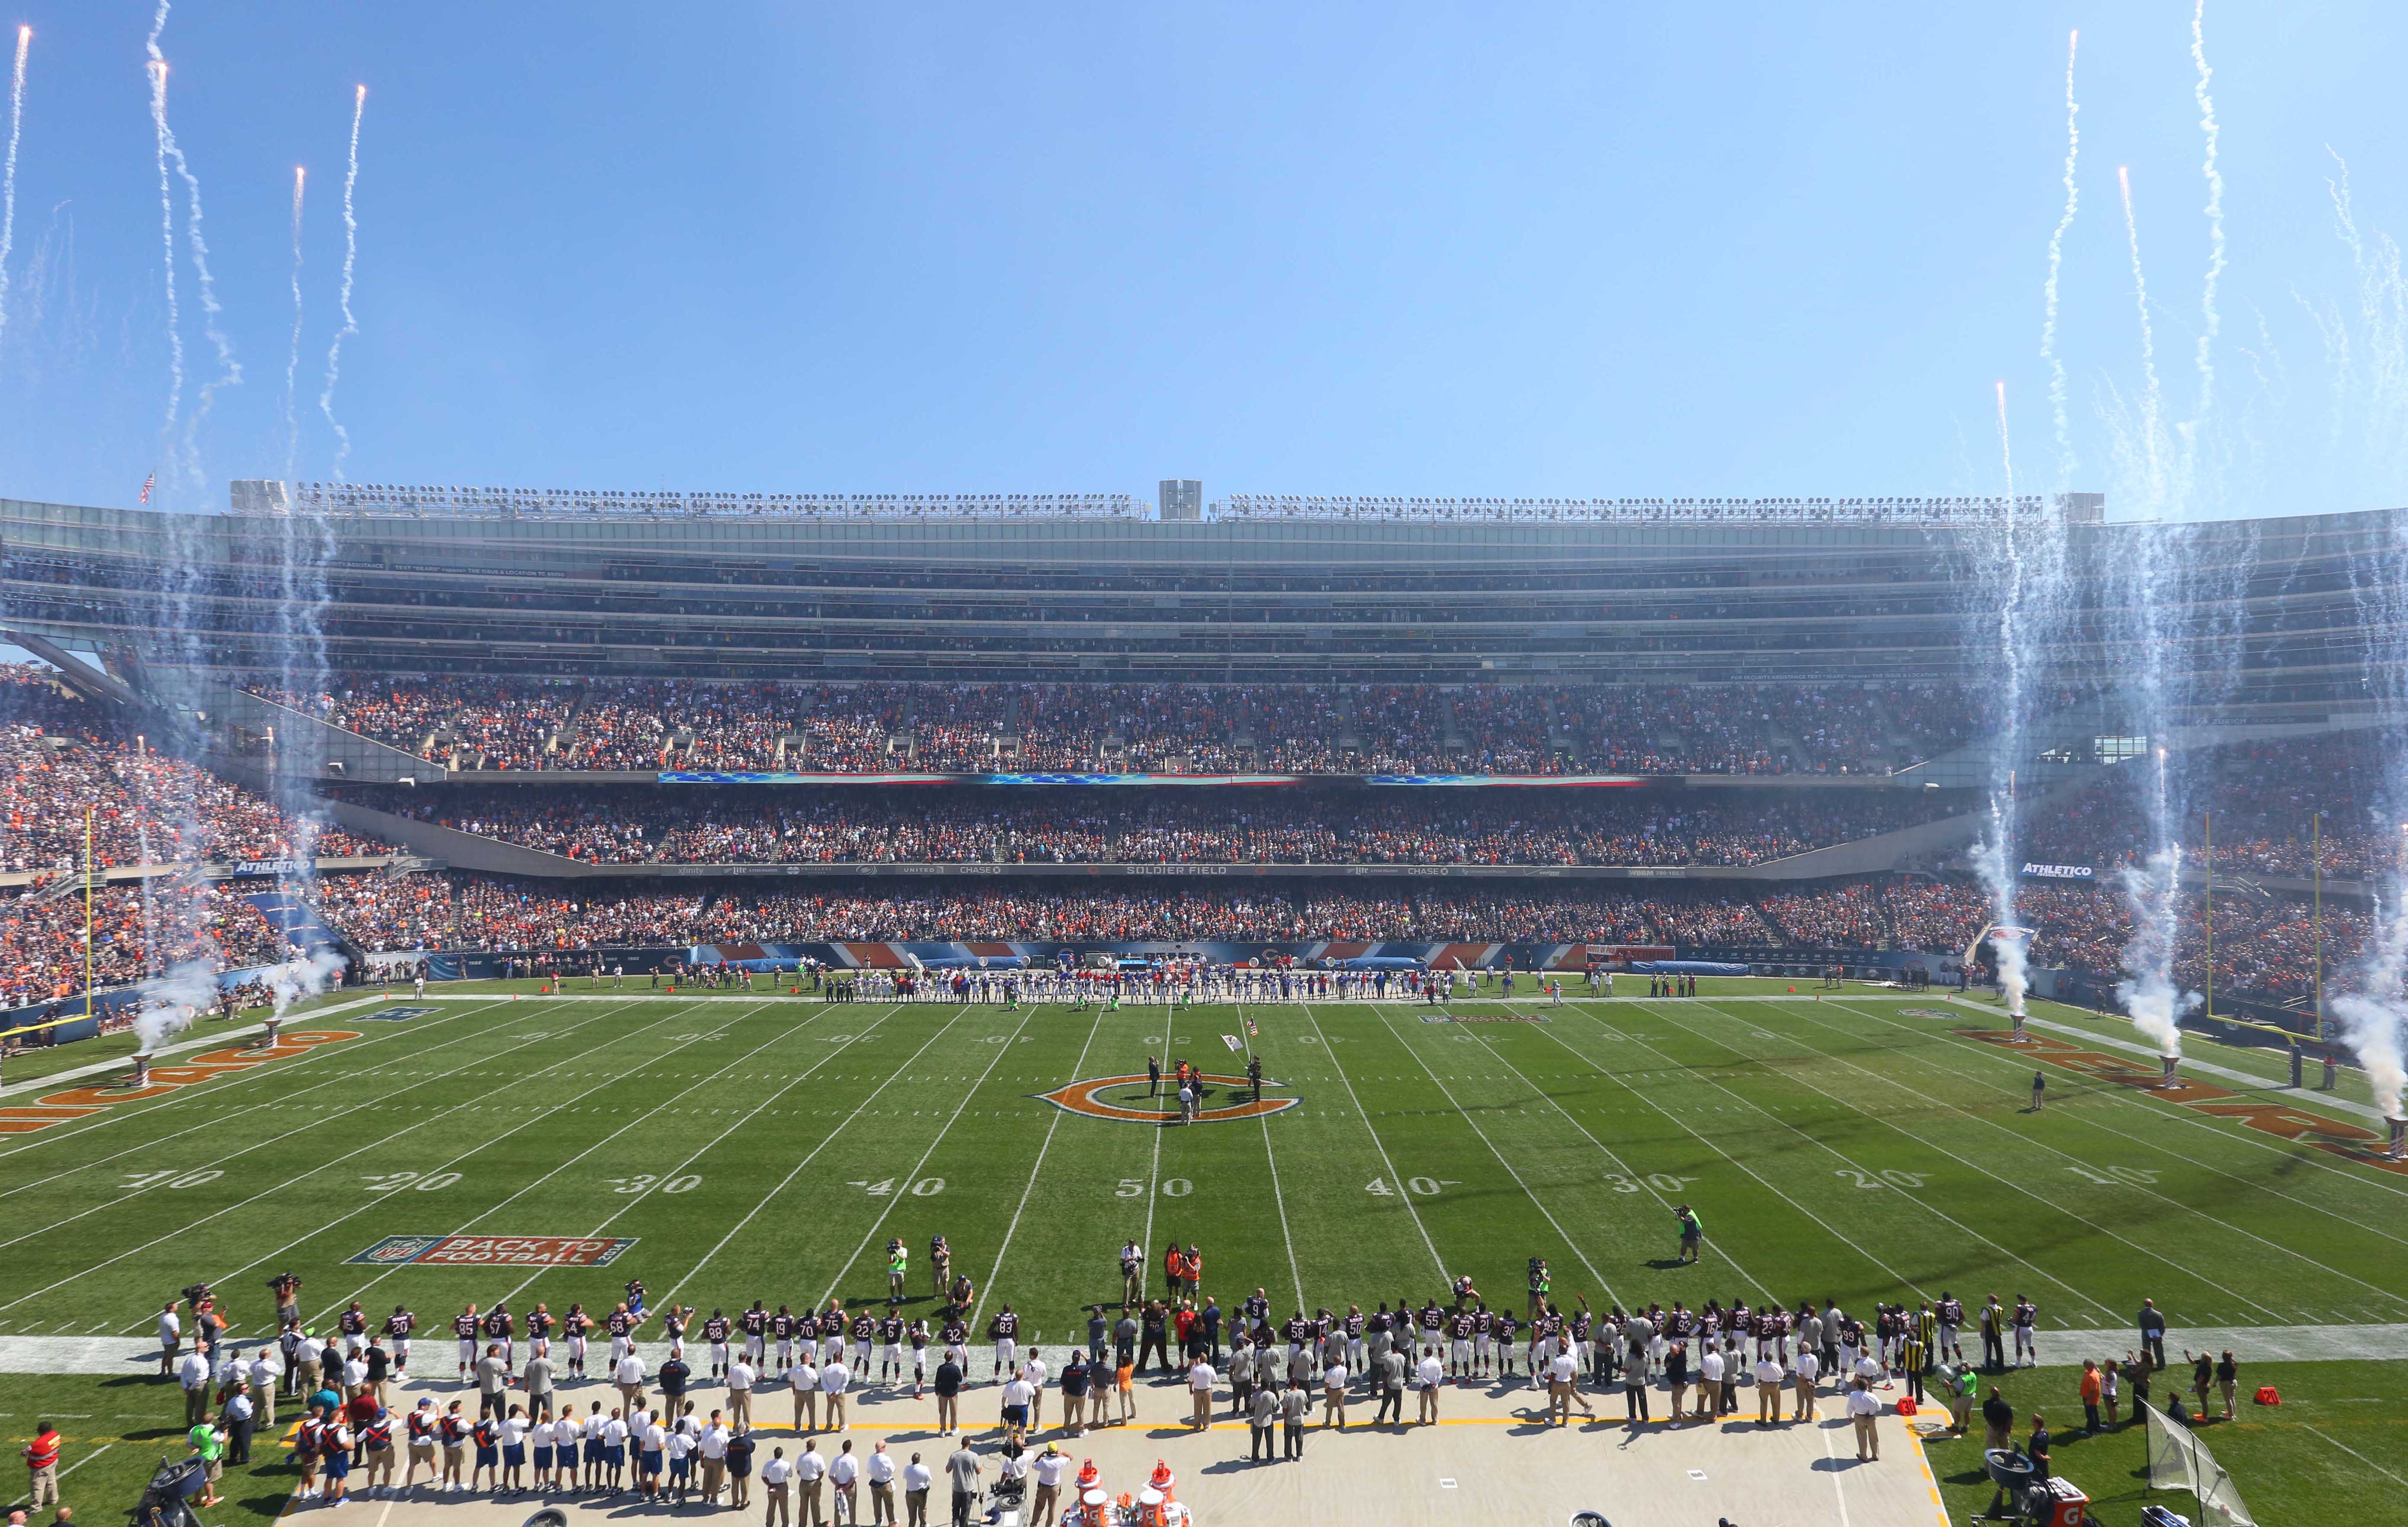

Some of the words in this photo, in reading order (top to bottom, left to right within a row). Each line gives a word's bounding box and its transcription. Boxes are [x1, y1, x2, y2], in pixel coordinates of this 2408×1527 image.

[678, 866, 704, 875] xfinity
[2022, 863, 2092, 876] ATHLETICO
[117, 1170, 225, 1189] 10
[1835, 1169, 1924, 1188] 20
[2064, 1165, 2159, 1185] 10
[364, 1172, 464, 1191] 20
[613, 1174, 702, 1193] 30
[866, 1177, 946, 1196] 40
[1114, 1178, 1194, 1197] 50
[1364, 1176, 1442, 1196] 40
[1602, 1174, 1685, 1193] 30
[442, 1239, 548, 1251] BACK
[558, 1241, 604, 1252] TO
[426, 1251, 585, 1263] FOOTBALL
[597, 1243, 627, 1261] 2014
[1253, 1305, 1258, 1315] 9
[1946, 1307, 1959, 1319] 90
[747, 1319, 760, 1331] 74
[825, 1319, 839, 1331] 75
[1425, 1315, 1438, 1326] 55
[1480, 1319, 1489, 1331] 21
[1678, 1320, 1690, 1332] 92
[1736, 1315, 1748, 1328] 95
[392, 1321, 407, 1334] 20
[459, 1323, 473, 1335] 85
[490, 1321, 500, 1335] 67
[610, 1321, 624, 1333] 68
[708, 1327, 723, 1339] 88
[776, 1323, 786, 1335] 19
[800, 1325, 814, 1337] 70
[856, 1325, 869, 1337] 22
[888, 1325, 895, 1338] 6
[999, 1322, 1013, 1333] 83
[1291, 1327, 1304, 1338] 58
[1350, 1324, 1362, 1335] 50
[1457, 1325, 1471, 1337] 57
[1502, 1326, 1515, 1336] 30
[1578, 1325, 1589, 1337] 27
[1706, 1322, 1715, 1334] 16
[947, 1329, 961, 1342] 32
[1843, 1331, 1854, 1341] 99
[2263, 1390, 2280, 1404] 20
[1902, 1400, 1917, 1414] 30
[1089, 1509, 1100, 1521] G
[1146, 1509, 1155, 1520] G
[2063, 1507, 2079, 1525] G
